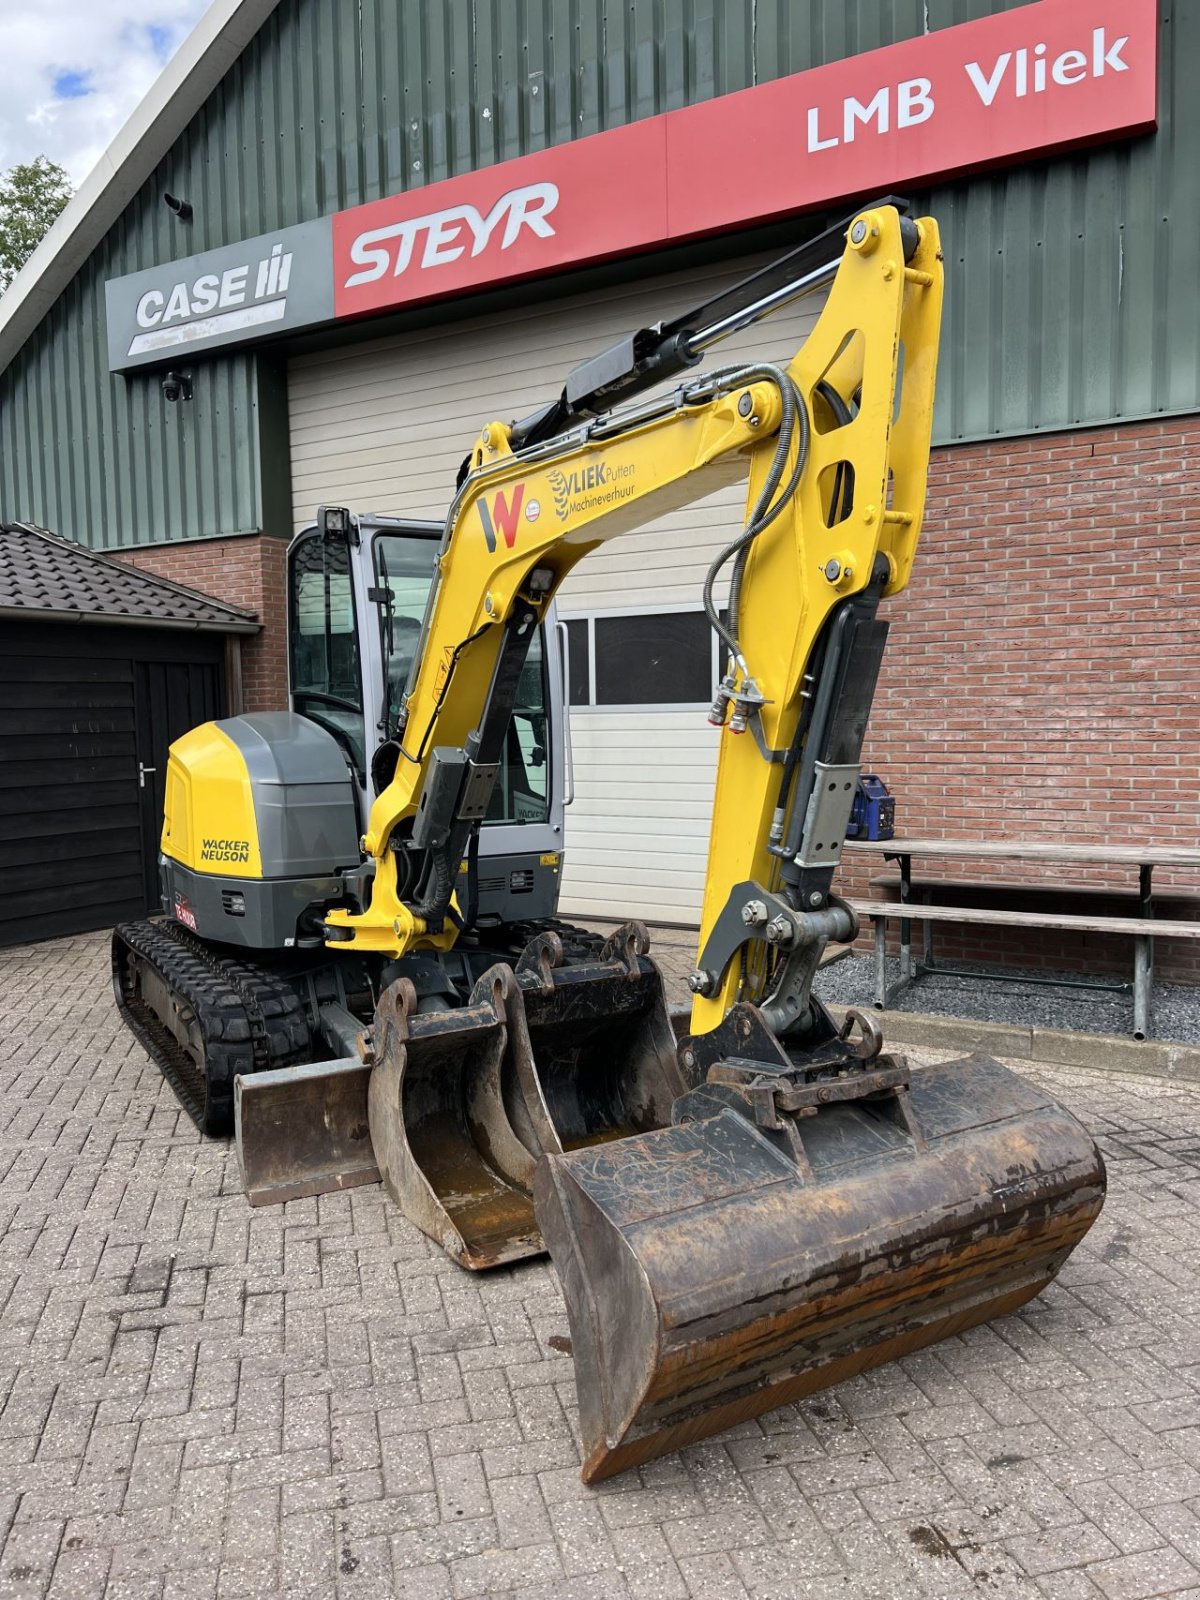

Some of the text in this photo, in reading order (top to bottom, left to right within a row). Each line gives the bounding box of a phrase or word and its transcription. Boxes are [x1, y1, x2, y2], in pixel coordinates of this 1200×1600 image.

[807, 26, 1130, 154] LMB Vliek
[344, 181, 560, 289] STEYR
[136, 264, 249, 328] CASE
[560, 462, 635, 496] VLIEK Putten
[569, 484, 635, 515] Machineverhuur
[476, 483, 525, 553] W
[200, 850, 250, 863] NEUSON
[202, 839, 250, 852] WACKER
